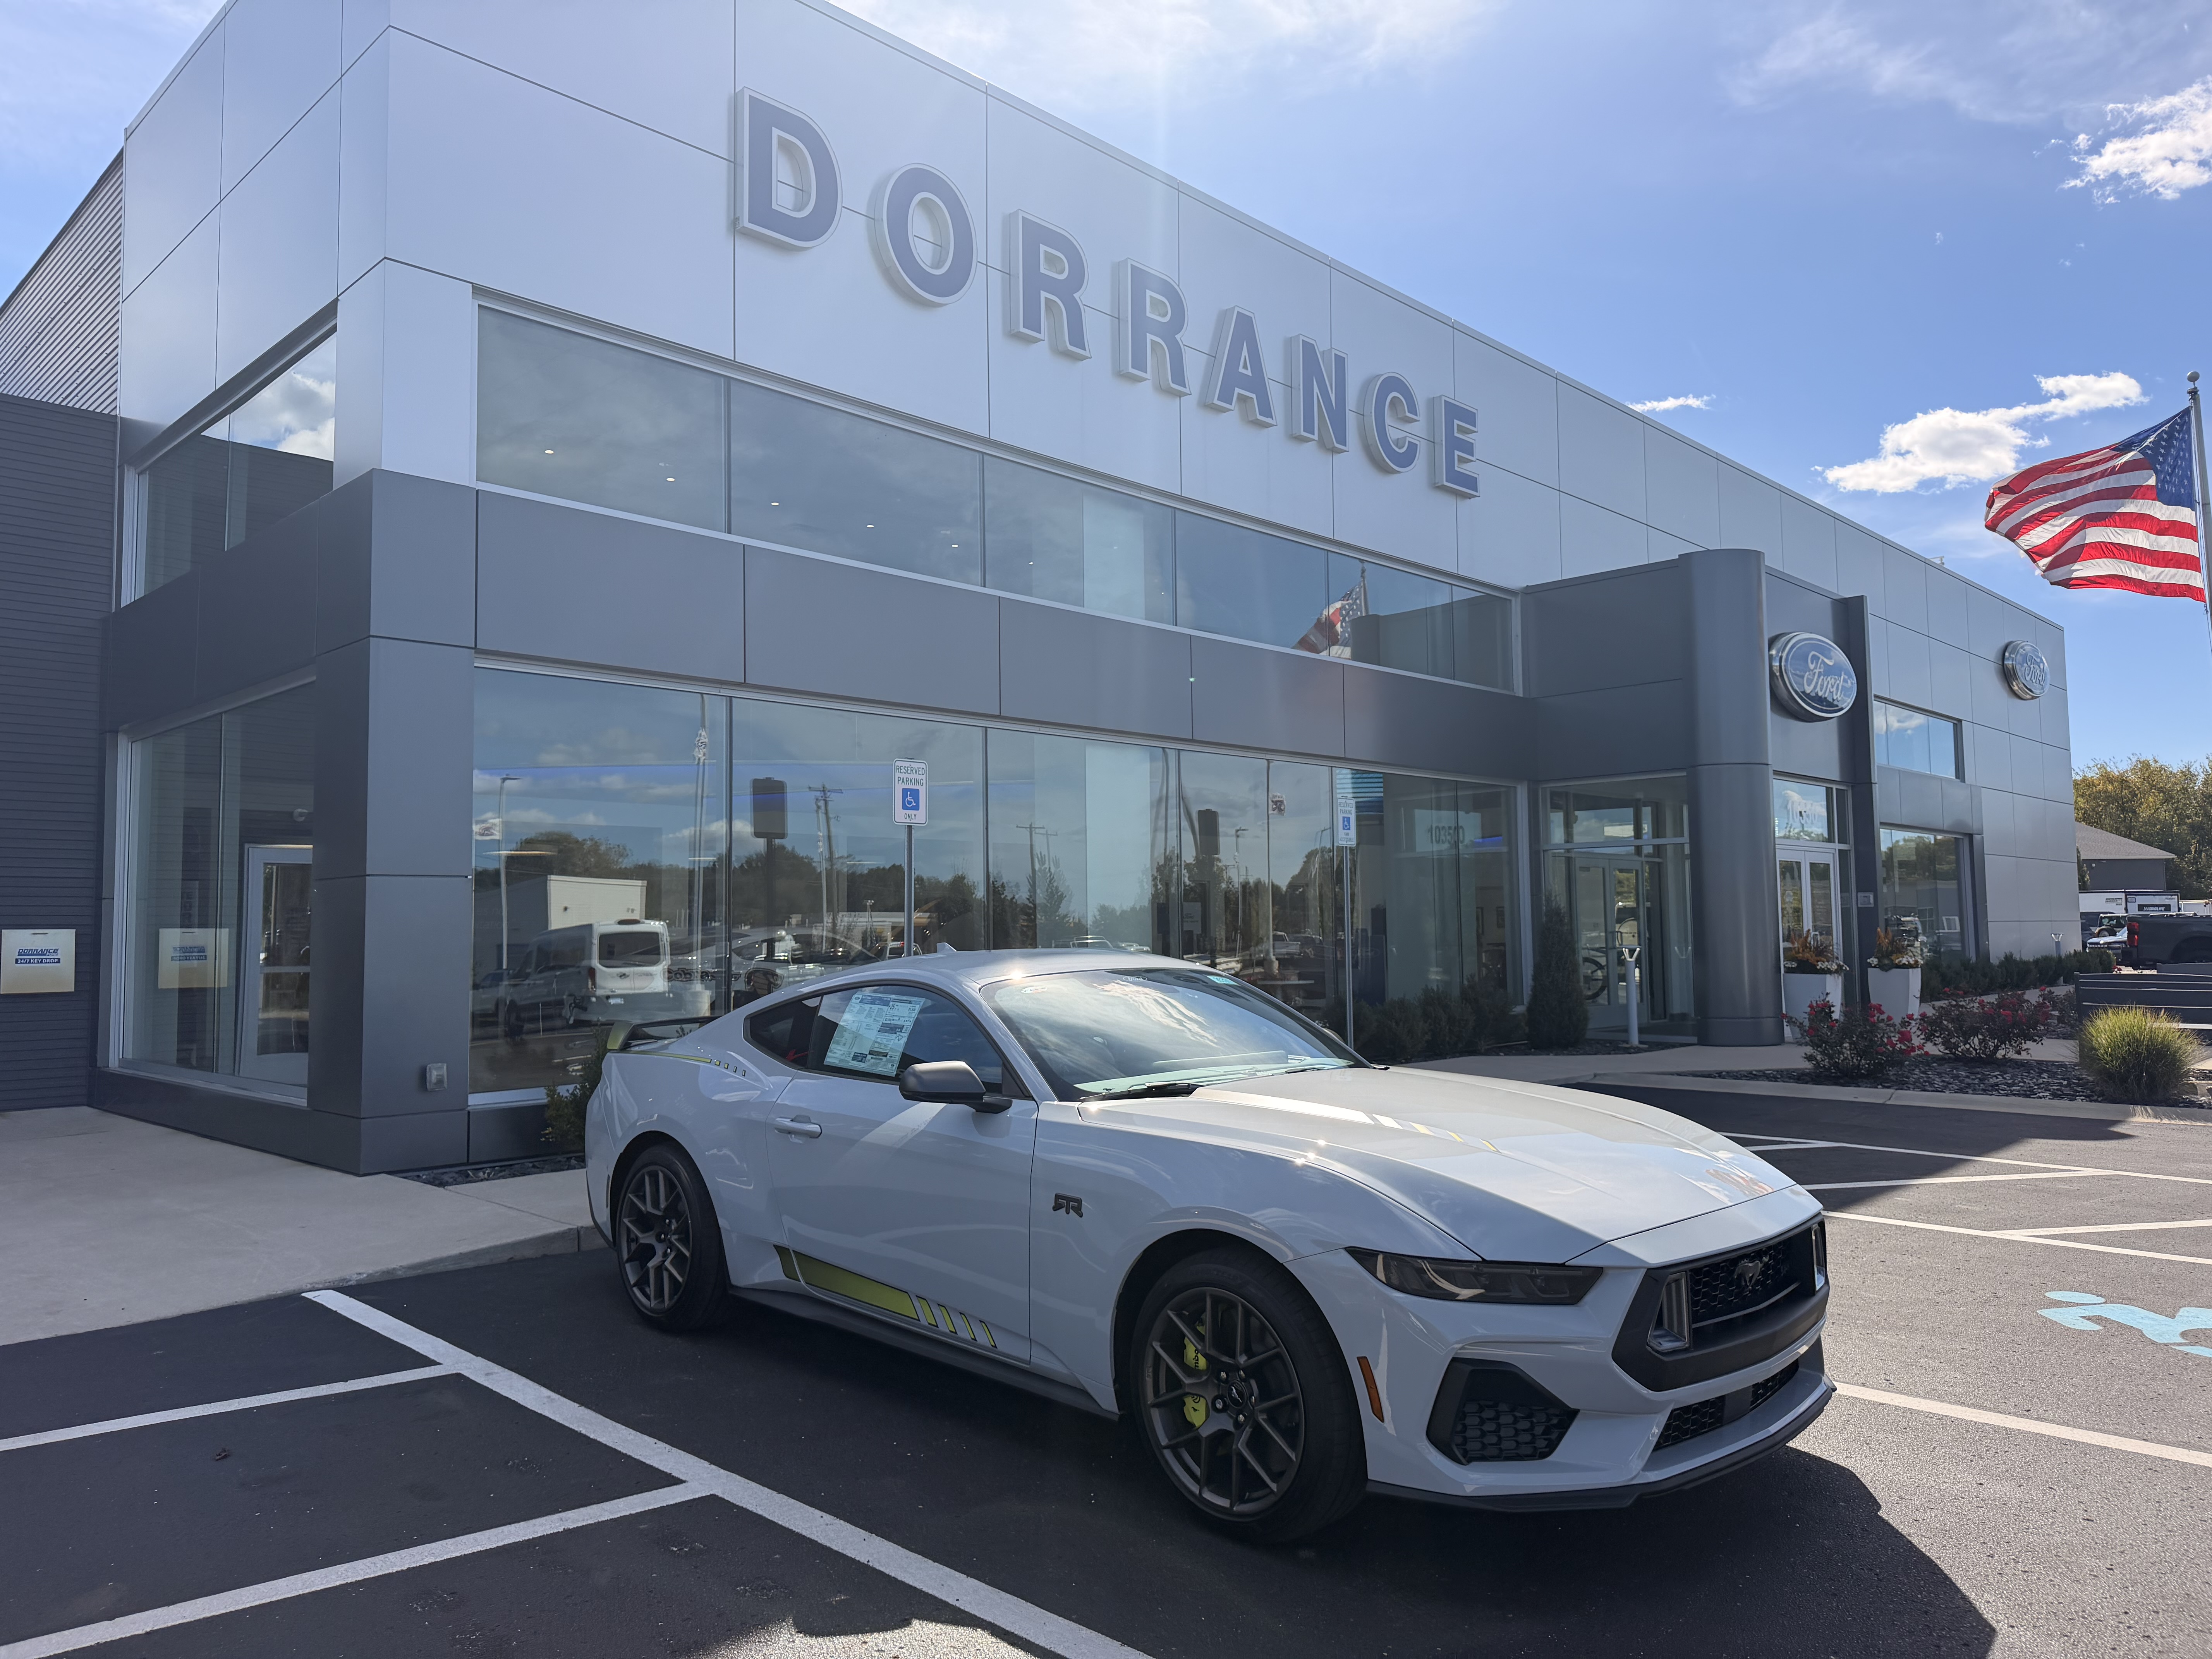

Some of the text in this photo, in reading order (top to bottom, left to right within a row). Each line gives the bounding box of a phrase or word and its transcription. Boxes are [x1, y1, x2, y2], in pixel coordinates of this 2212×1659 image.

[735, 86, 1480, 499] DORRANCE
[1804, 651, 1844, 701] Ford
[2025, 653, 2045, 686] Ford
[896, 765, 925, 775] RESERVED
[897, 776, 924, 786] PARKING
